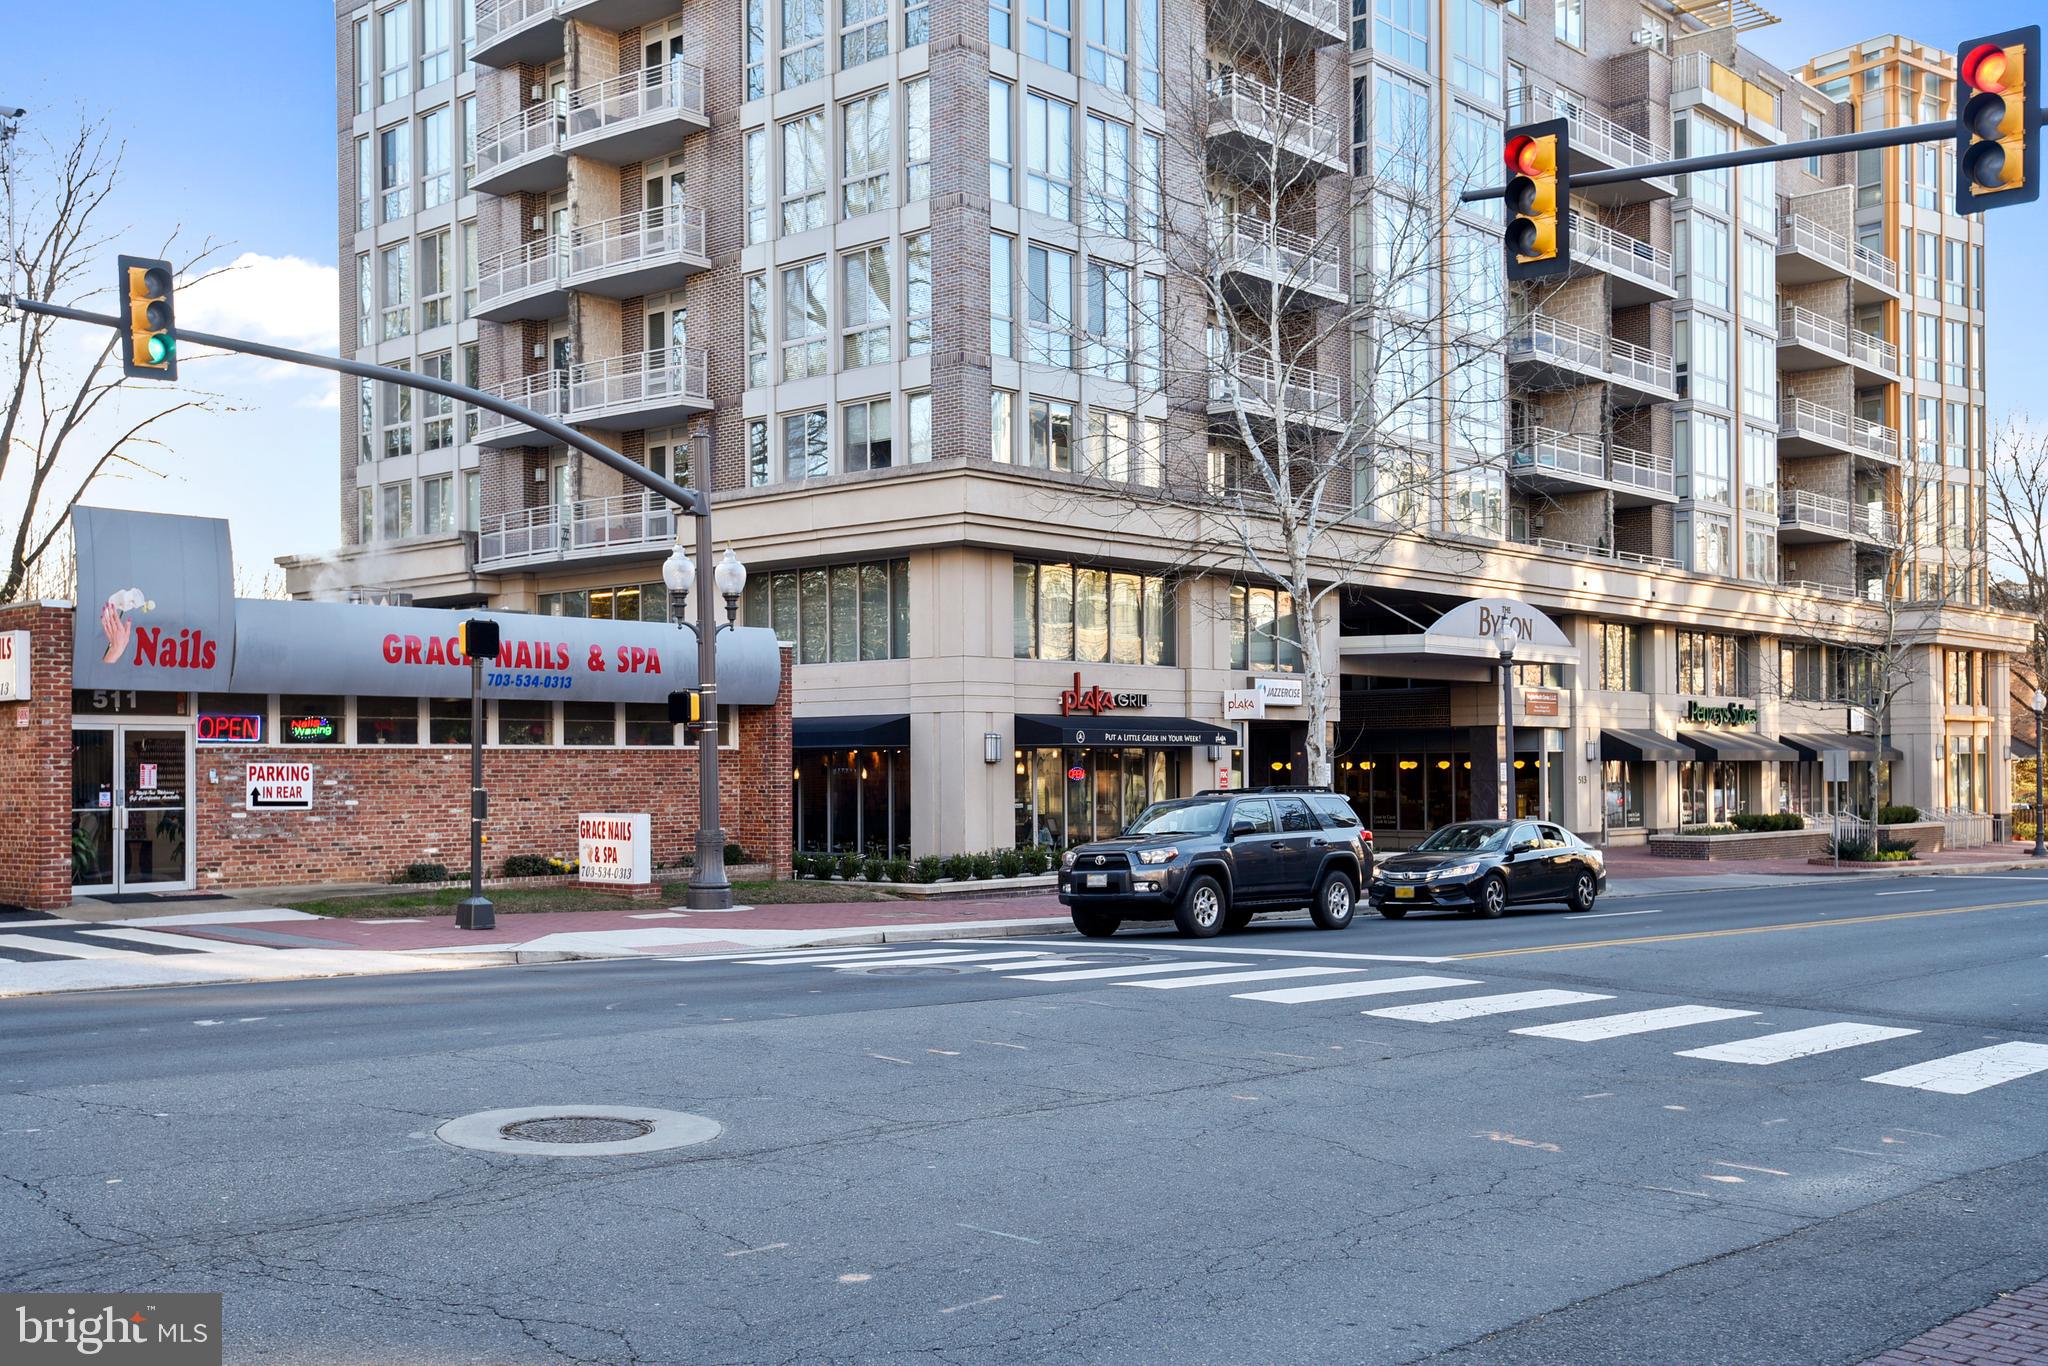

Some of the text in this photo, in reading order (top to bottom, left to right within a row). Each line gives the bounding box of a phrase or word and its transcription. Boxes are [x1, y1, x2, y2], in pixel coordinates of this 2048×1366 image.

[1502, 606, 1511, 614] THE
[1479, 606, 1533, 641] BYON
[133, 626, 217, 669] Nails
[382, 633, 662, 675] GRAC NAILS & SPA
[487, 673, 573, 689] 703-534-0313
[92, 690, 137, 709] 511
[1267, 687, 1301, 698] JAZZERCISE
[198, 716, 259, 740] OPEN
[290, 718, 321, 729] Nails
[293, 726, 332, 736] Waxing
[1105, 733, 1116, 741] PUT
[1123, 733, 1141, 742] LITTLE
[1141, 733, 1158, 742] GREEK
[1167, 734, 1183, 742] YOUR
[1184, 734, 1201, 743] WEEK!
[248, 765, 310, 782] PARKING
[1578, 775, 1587, 784] 513
[262, 786, 303, 799] IN REAR
[580, 820, 632, 841] GRACE NAILS
[594, 845, 618, 864] & SPA
[581, 865, 632, 880] 703-534-0313
